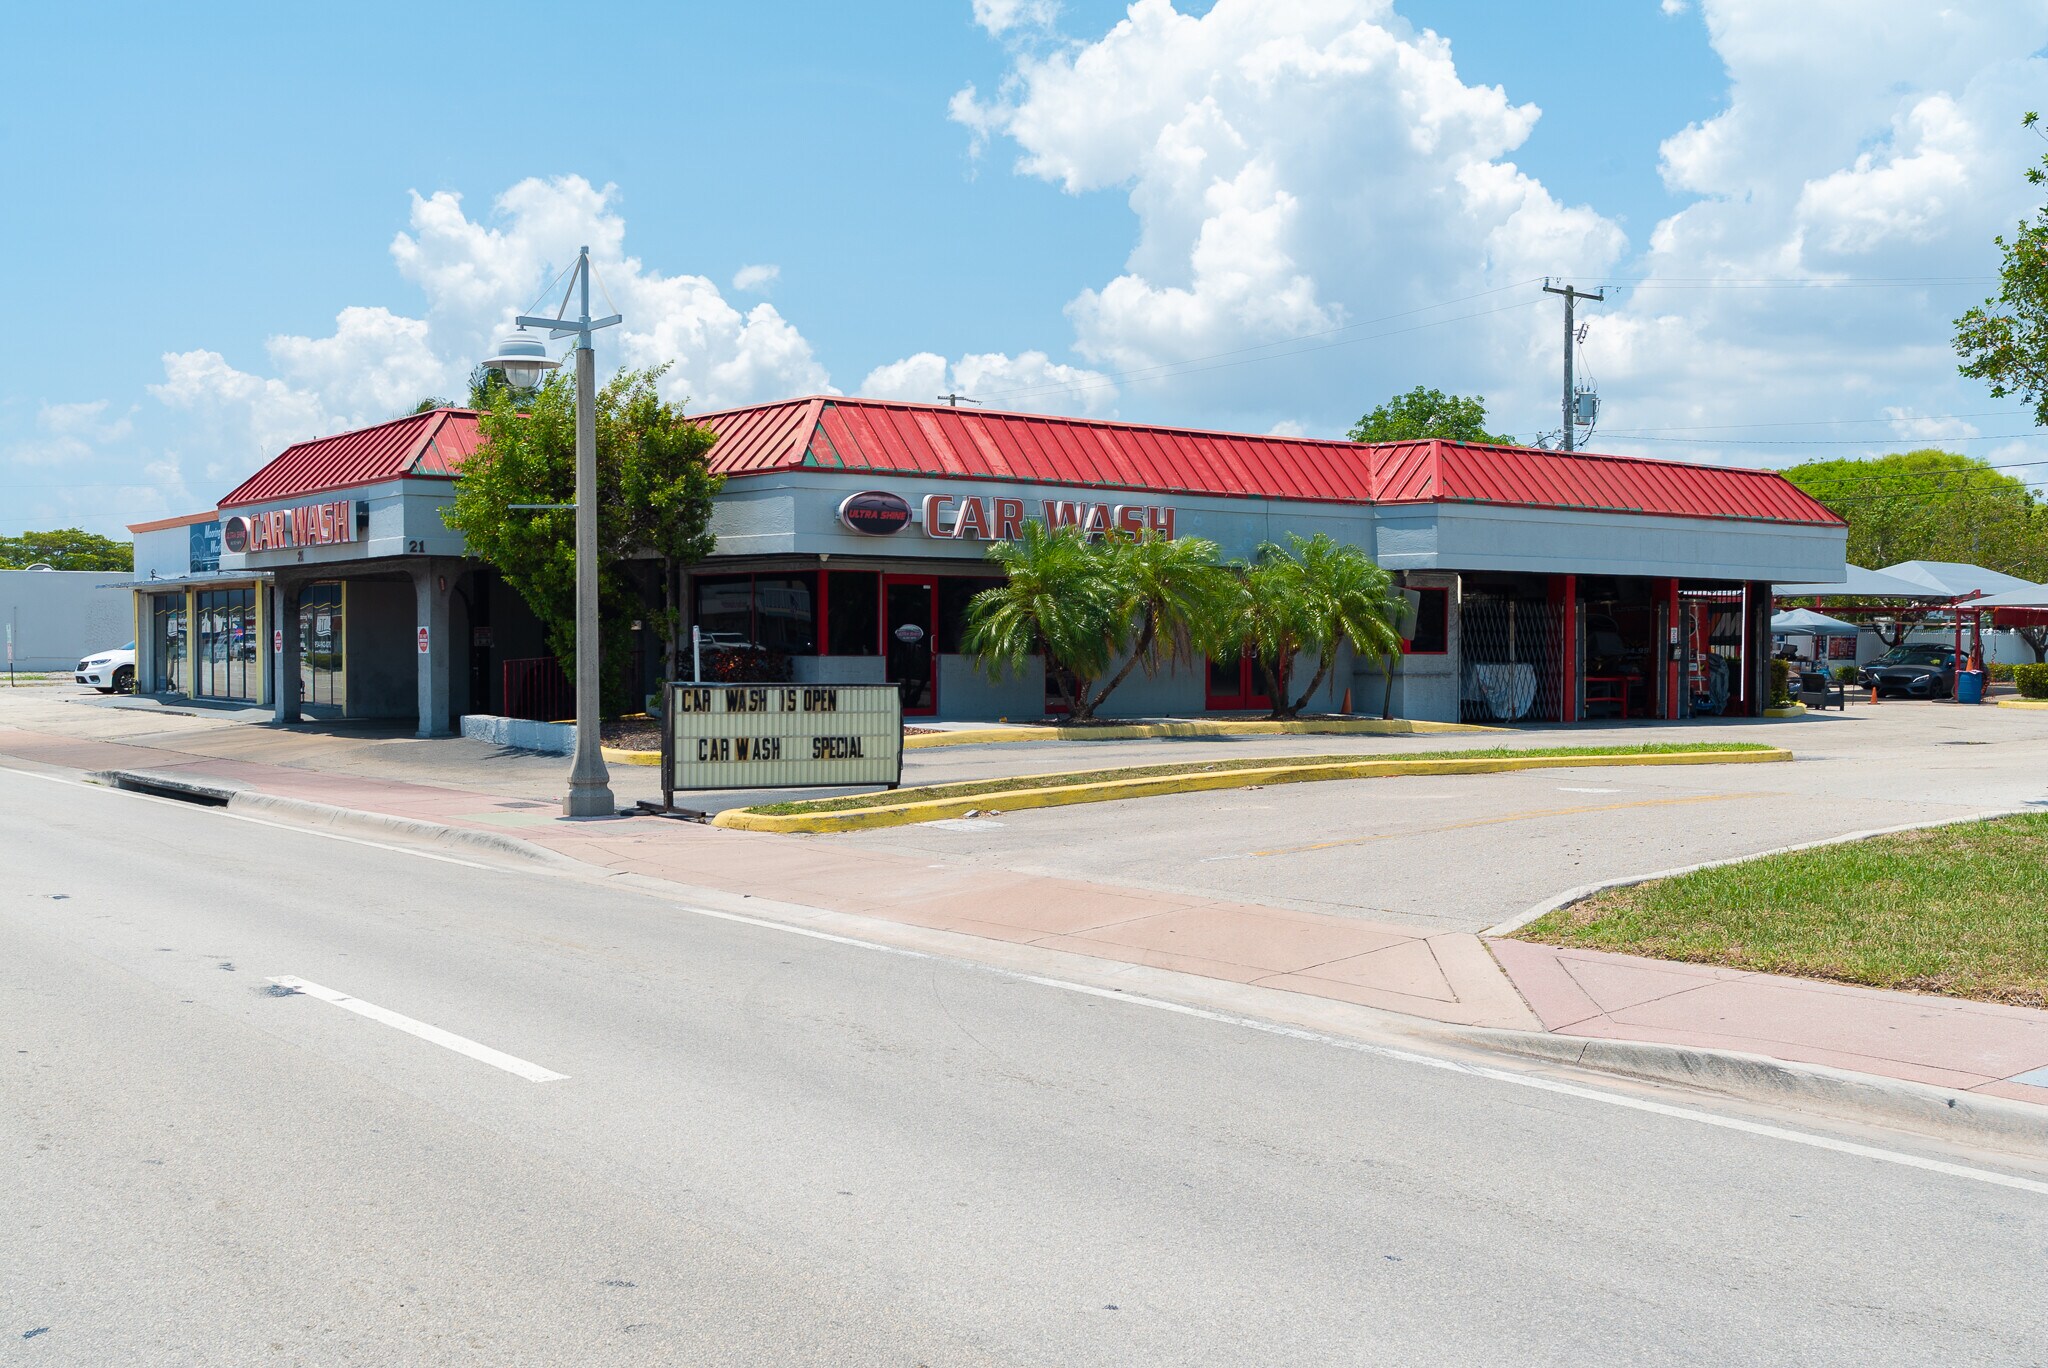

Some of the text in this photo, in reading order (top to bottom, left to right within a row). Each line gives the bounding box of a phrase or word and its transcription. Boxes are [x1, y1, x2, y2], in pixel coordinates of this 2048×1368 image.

[250, 500, 349, 551] CAR WASH
[849, 509, 907, 520] ULTRA SHINE
[922, 493, 1176, 546] CAR WASH
[409, 540, 425, 552] 21
[682, 689, 837, 712] CAR WASH IS OPEN
[698, 736, 864, 761] CAR WASH SPECIAL
